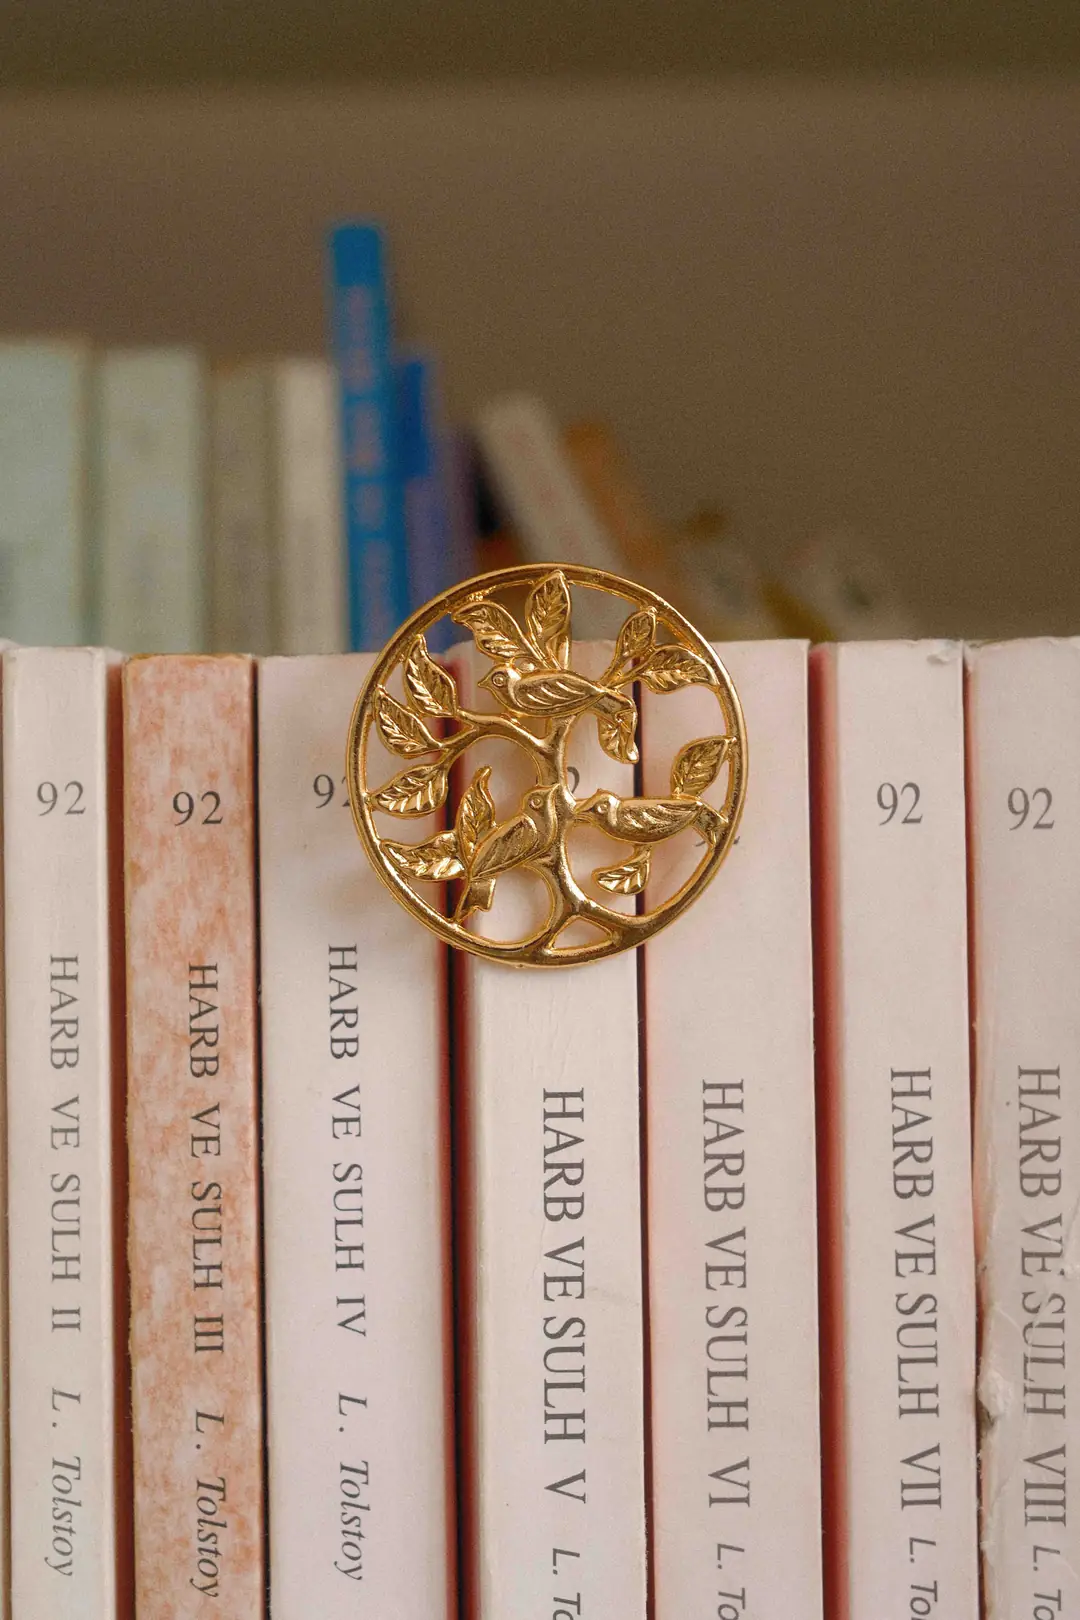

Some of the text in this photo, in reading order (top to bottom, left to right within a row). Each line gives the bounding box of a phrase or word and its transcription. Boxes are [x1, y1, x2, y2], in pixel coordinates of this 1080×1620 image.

[36, 780, 86, 816] 92
[172, 790, 223, 827] 92
[313, 773, 351, 809] 9
[876, 781, 923, 826] 92
[1007, 787, 1055, 831] 92
[50, 955, 81, 1331] HARB VE SULH II
[188, 962, 224, 1353] HARB VE SULH III
[328, 944, 367, 1337] HARB VE SULH IV
[542, 1087, 587, 1504] HARB VE SULH V
[702, 1079, 751, 1507] HARB VE SULH VI
[890, 1067, 942, 1510] HARB VE SULH VII
[1017, 1065, 1067, 1527] HARB VE SULH VIII
[43, 1387, 82, 1577] L. Tolstoy
[189, 1410, 228, 1598] L. Tolstoy
[333, 1393, 371, 1581] L. Tolstoy
[552, 1547, 581, 1575] L.
[716, 1543, 746, 1570] L.
[909, 1536, 937, 1564] L.
[1032, 1544, 1061, 1572] L.
